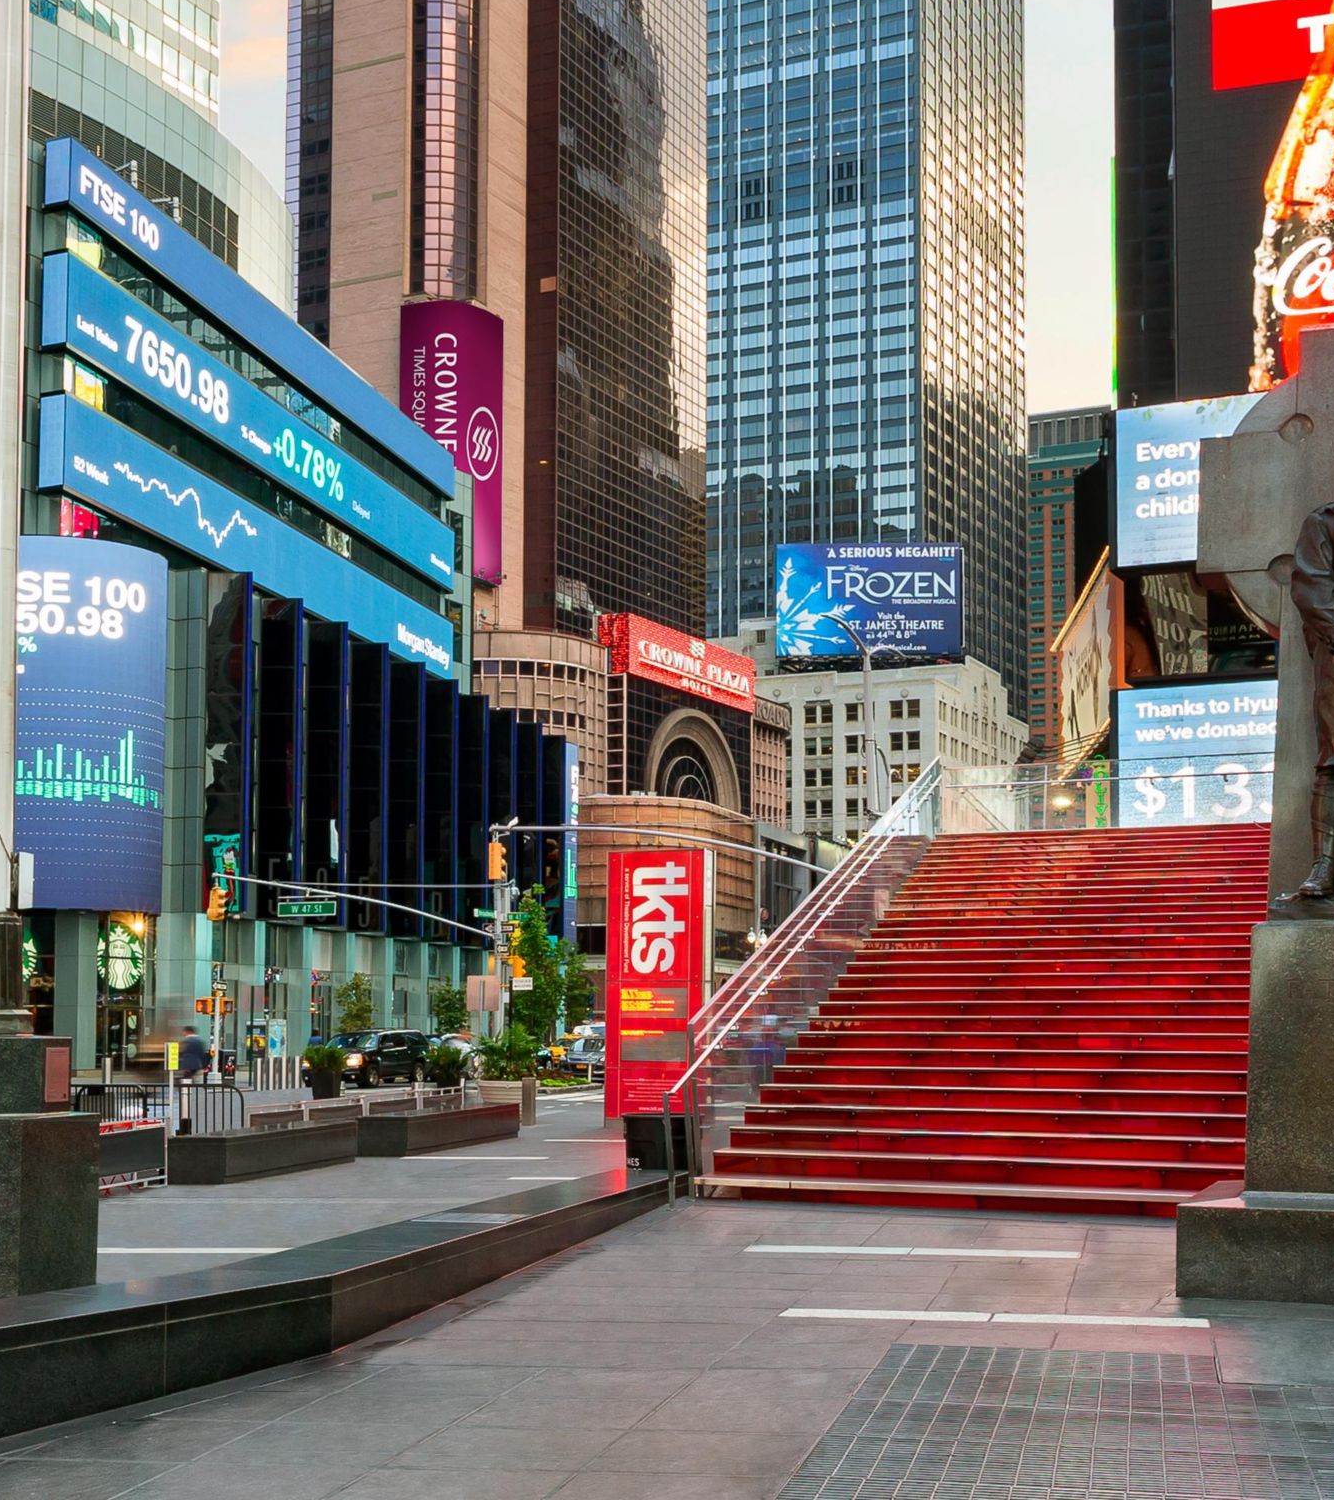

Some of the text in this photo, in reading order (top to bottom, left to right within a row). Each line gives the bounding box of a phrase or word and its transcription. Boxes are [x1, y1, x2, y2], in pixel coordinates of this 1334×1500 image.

[79, 164, 160, 252] FTSE 100
[124, 315, 230, 425] 7650.98
[413, 346, 426, 387] TIMES
[73, 455, 110, 486] 52 Week
[273, 427, 344, 502] +0.78%
[1136, 474, 1150, 491] a
[839, 546, 892, 559] SERIOUS
[17, 571, 146, 613] SE 100
[825, 566, 956, 605] FROZEN
[17, 604, 124, 640] 50.98
[864, 620, 897, 631] JAMES
[899, 620, 944, 630] THEATRE
[877, 611, 906, 620] Visit the
[397, 622, 451, 670] Morgan Stanley
[638, 639, 750, 693] CROWNE PLAZA
[1136, 696, 1278, 719] Thanks to Hyu
[1136, 724, 1193, 742] we've
[291, 903, 322, 913] W 47 St
